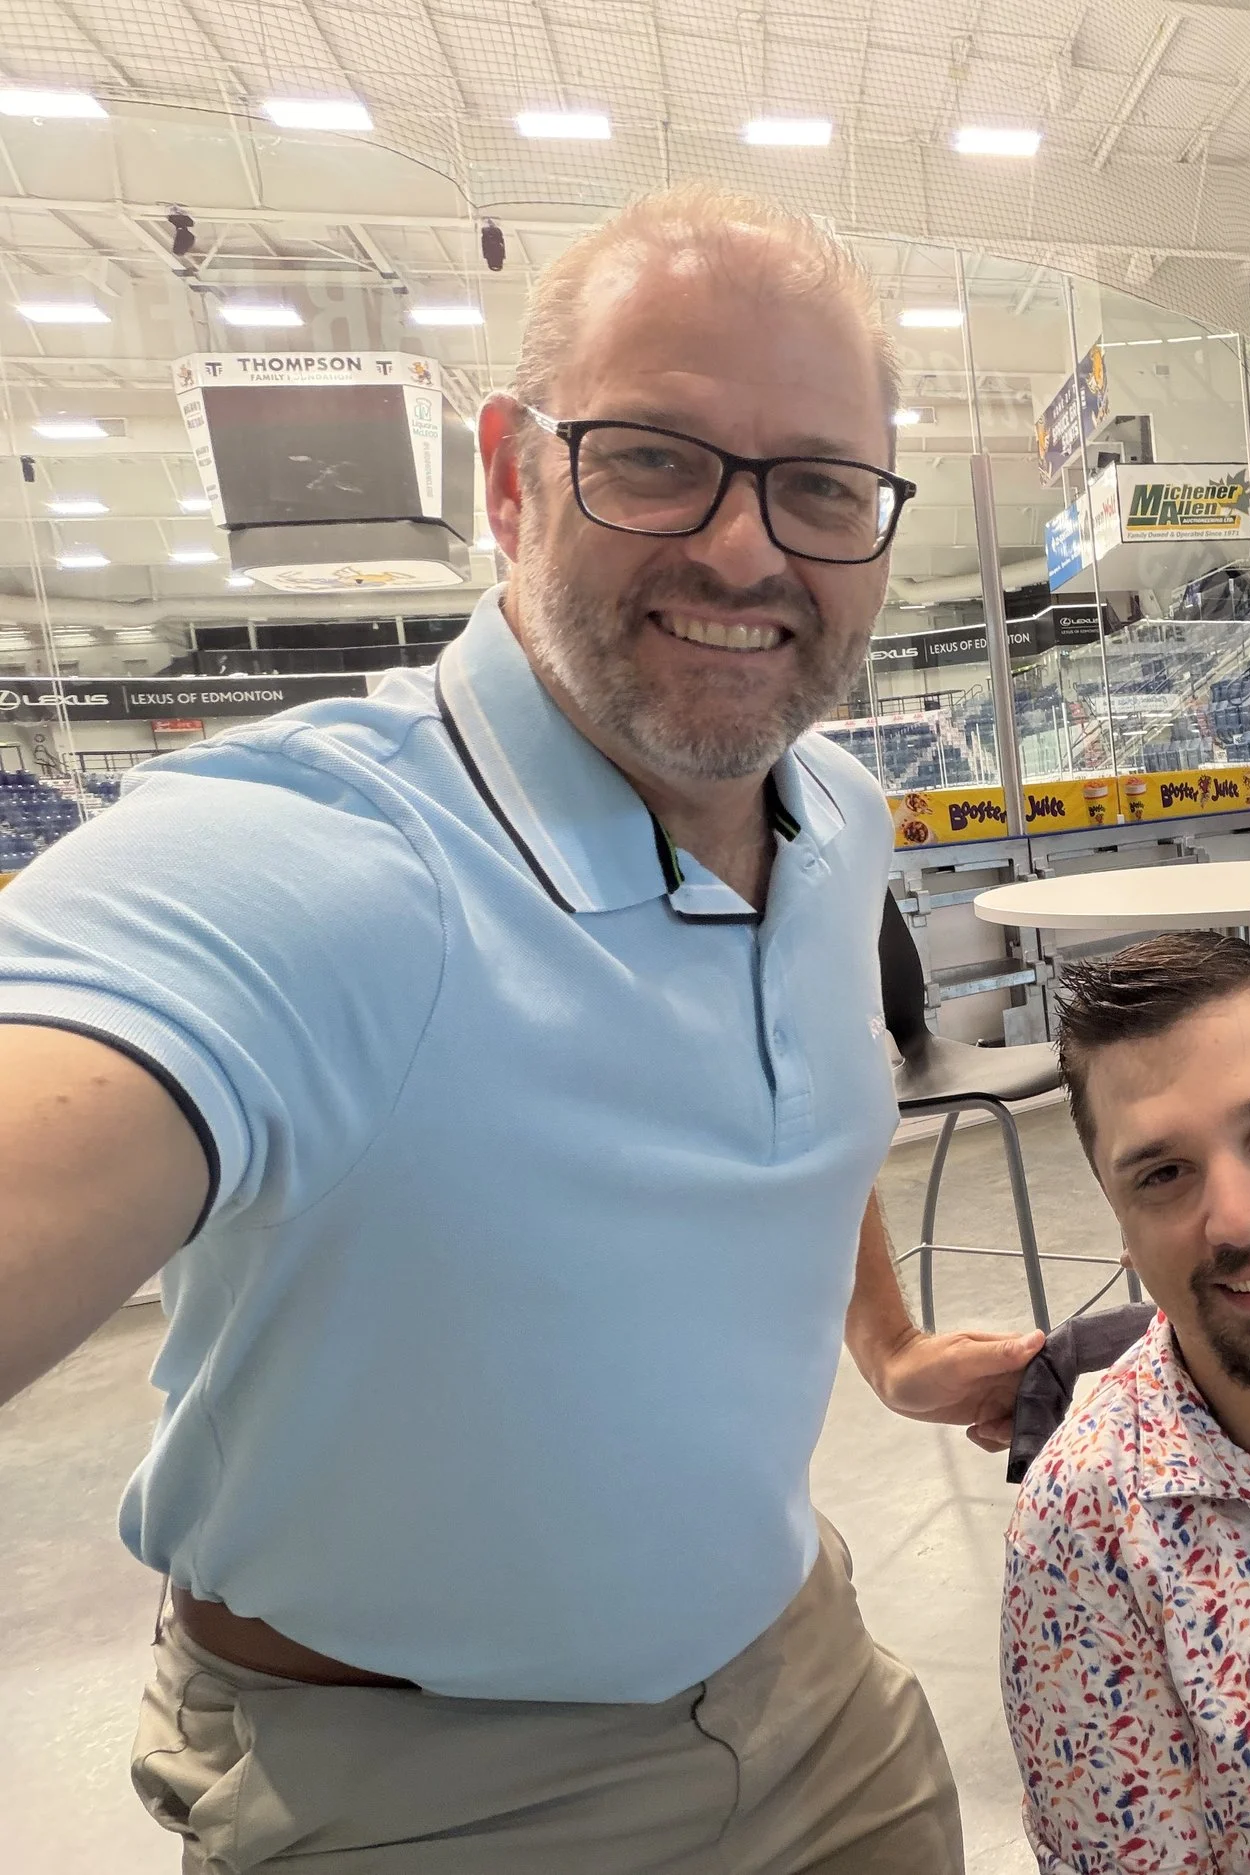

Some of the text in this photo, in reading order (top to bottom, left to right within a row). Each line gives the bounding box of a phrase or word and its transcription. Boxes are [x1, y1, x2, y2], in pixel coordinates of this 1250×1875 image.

[237, 357, 362, 372] THOMPSON
[250, 374, 284, 382] FAMILY
[1129, 483, 1240, 516] Michener
[1157, 500, 1219, 526] Allen
[929, 632, 1031, 655] LEXUS OF EDTON
[867, 647, 919, 661] EXUS
[22, 694, 110, 706] LEXUS
[130, 690, 285, 706] LEXUS OF EDMONTON
[1160, 778, 1240, 809] Booster Juice
[948, 795, 1066, 831] Booster Juice
